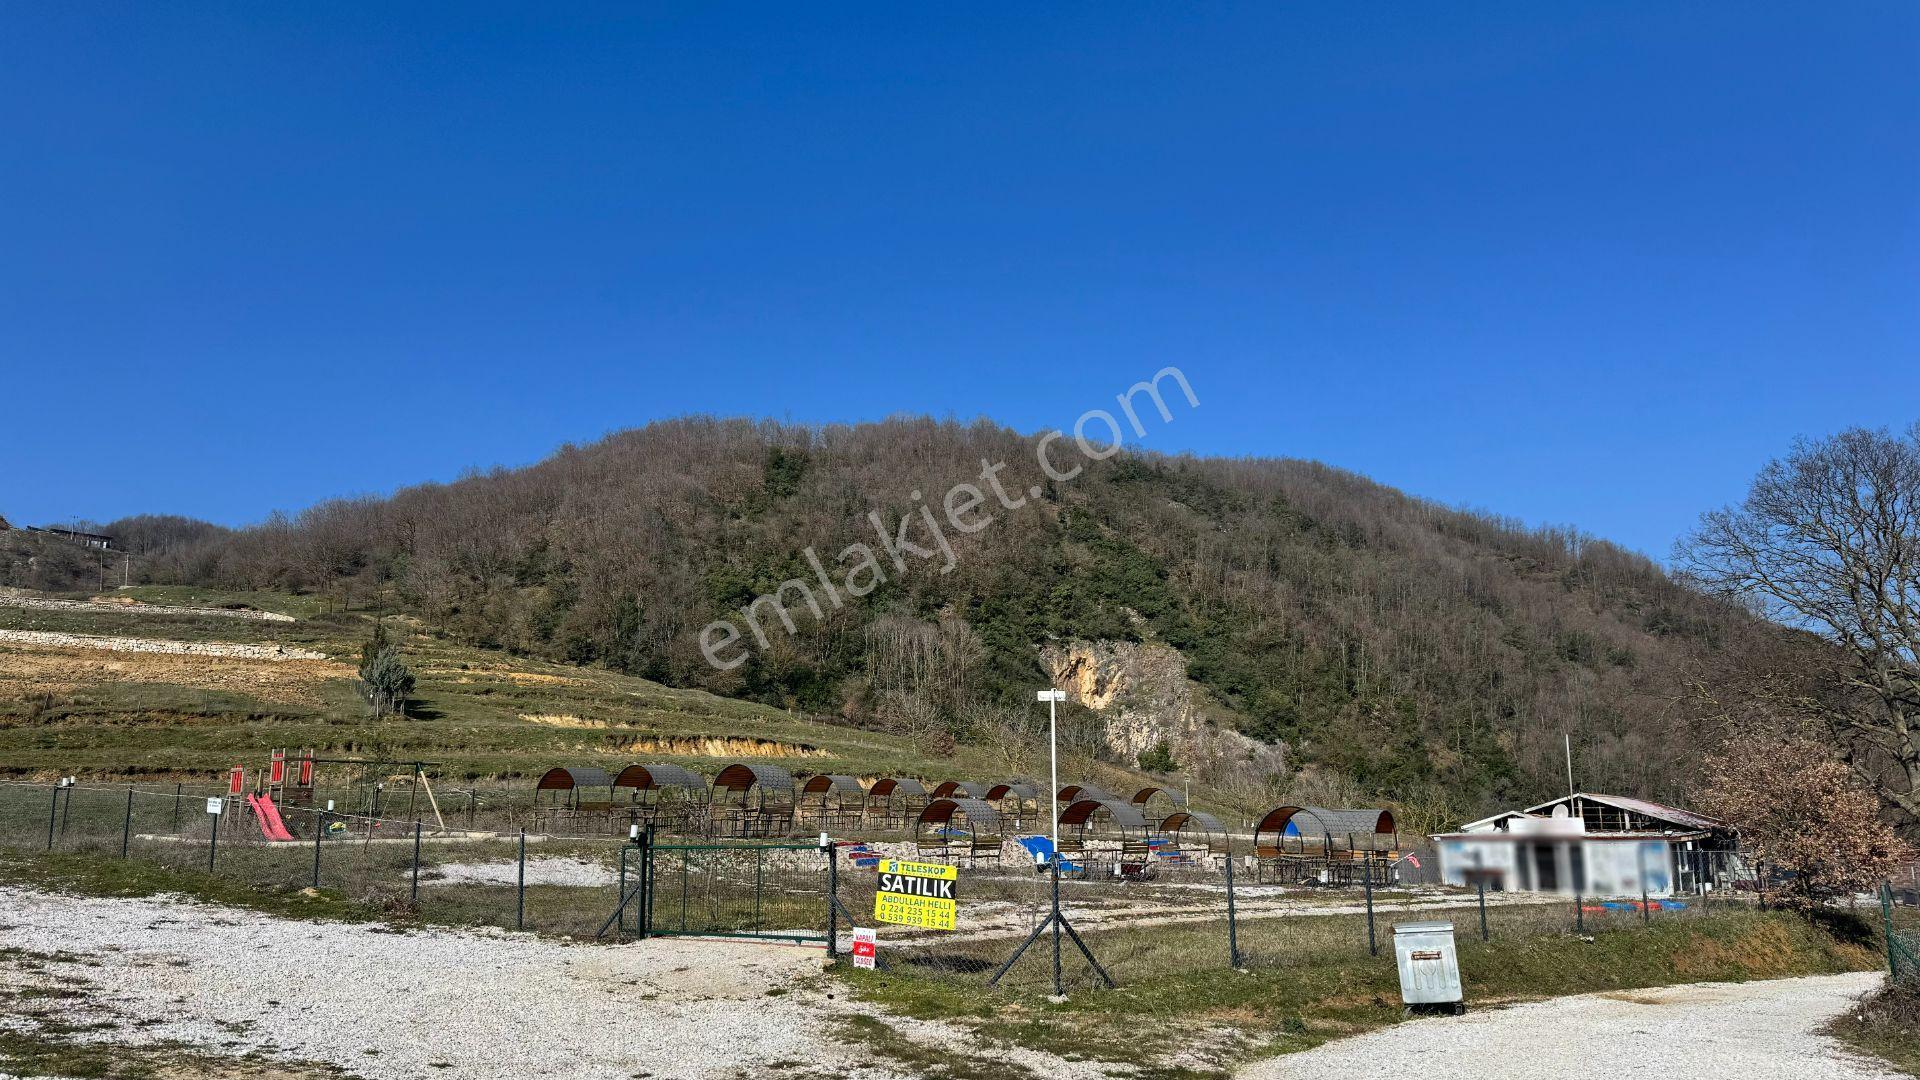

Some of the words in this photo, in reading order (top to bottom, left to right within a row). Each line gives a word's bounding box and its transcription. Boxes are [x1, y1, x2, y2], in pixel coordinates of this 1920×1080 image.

[901, 863, 946, 875] TELESKOP
[881, 874, 953, 898] SATILIK
[882, 895, 926, 907] ABDULLAH
[889, 904, 904, 913] 224
[907, 907, 923, 916] 235
[926, 909, 936, 918] 15
[939, 911, 950, 919] 44
[888, 913, 904, 922] 539
[906, 916, 923, 925] 939
[926, 918, 936, 927] 15
[939, 920, 950, 928] 44
